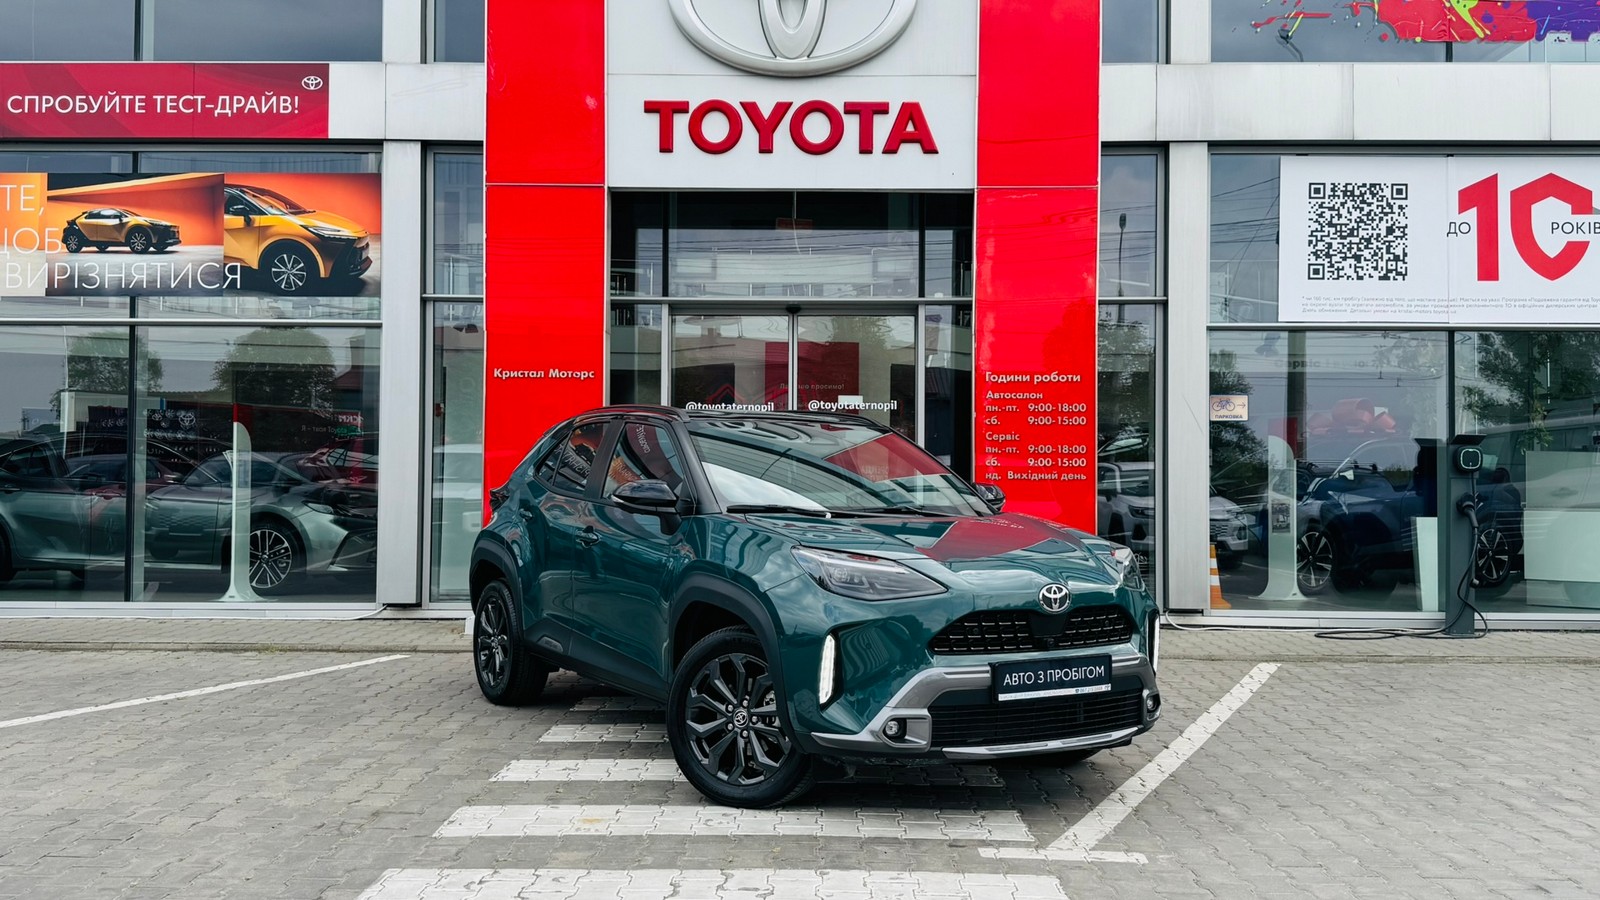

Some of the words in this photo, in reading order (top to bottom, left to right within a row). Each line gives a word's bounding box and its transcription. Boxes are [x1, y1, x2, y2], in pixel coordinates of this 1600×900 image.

[7, 90, 146, 114] СПРОБУЙТЕ
[153, 90, 299, 118] ТЕСТ-ДРАЙВ!
[643, 99, 940, 156] TOYOTA
[1446, 221, 1472, 238] ДО
[5, 262, 241, 289] ВИРІЗНЯТИСЯ
[493, 368, 545, 380] Кристал
[548, 368, 595, 381] Моторс
[985, 371, 1031, 384] Години
[1033, 370, 1081, 385] роботи
[985, 390, 1043, 399] Автосалон
[808, 399, 898, 412] @toyotaternopil
[985, 403, 1020, 413] пн.-пт.
[1027, 403, 1087, 413] 9:00-18:00
[985, 415, 1001, 426] сб.
[1027, 415, 1087, 426] 9:00-15:00
[985, 431, 1020, 442] Сервіс
[985, 444, 1020, 454] пн.-пт.
[1027, 444, 1087, 454] 9:00-18:00
[985, 456, 1001, 467] сб.
[1027, 457, 1087, 467] 9:00-15:00
[985, 471, 1002, 482] нд.
[1007, 469, 1058, 481] Вихідний
[1060, 471, 1087, 482] день
[1003, 672, 1035, 686] АВТО
[1037, 671, 1044, 683] З
[1047, 665, 1105, 682] ПРОБІГОМ
